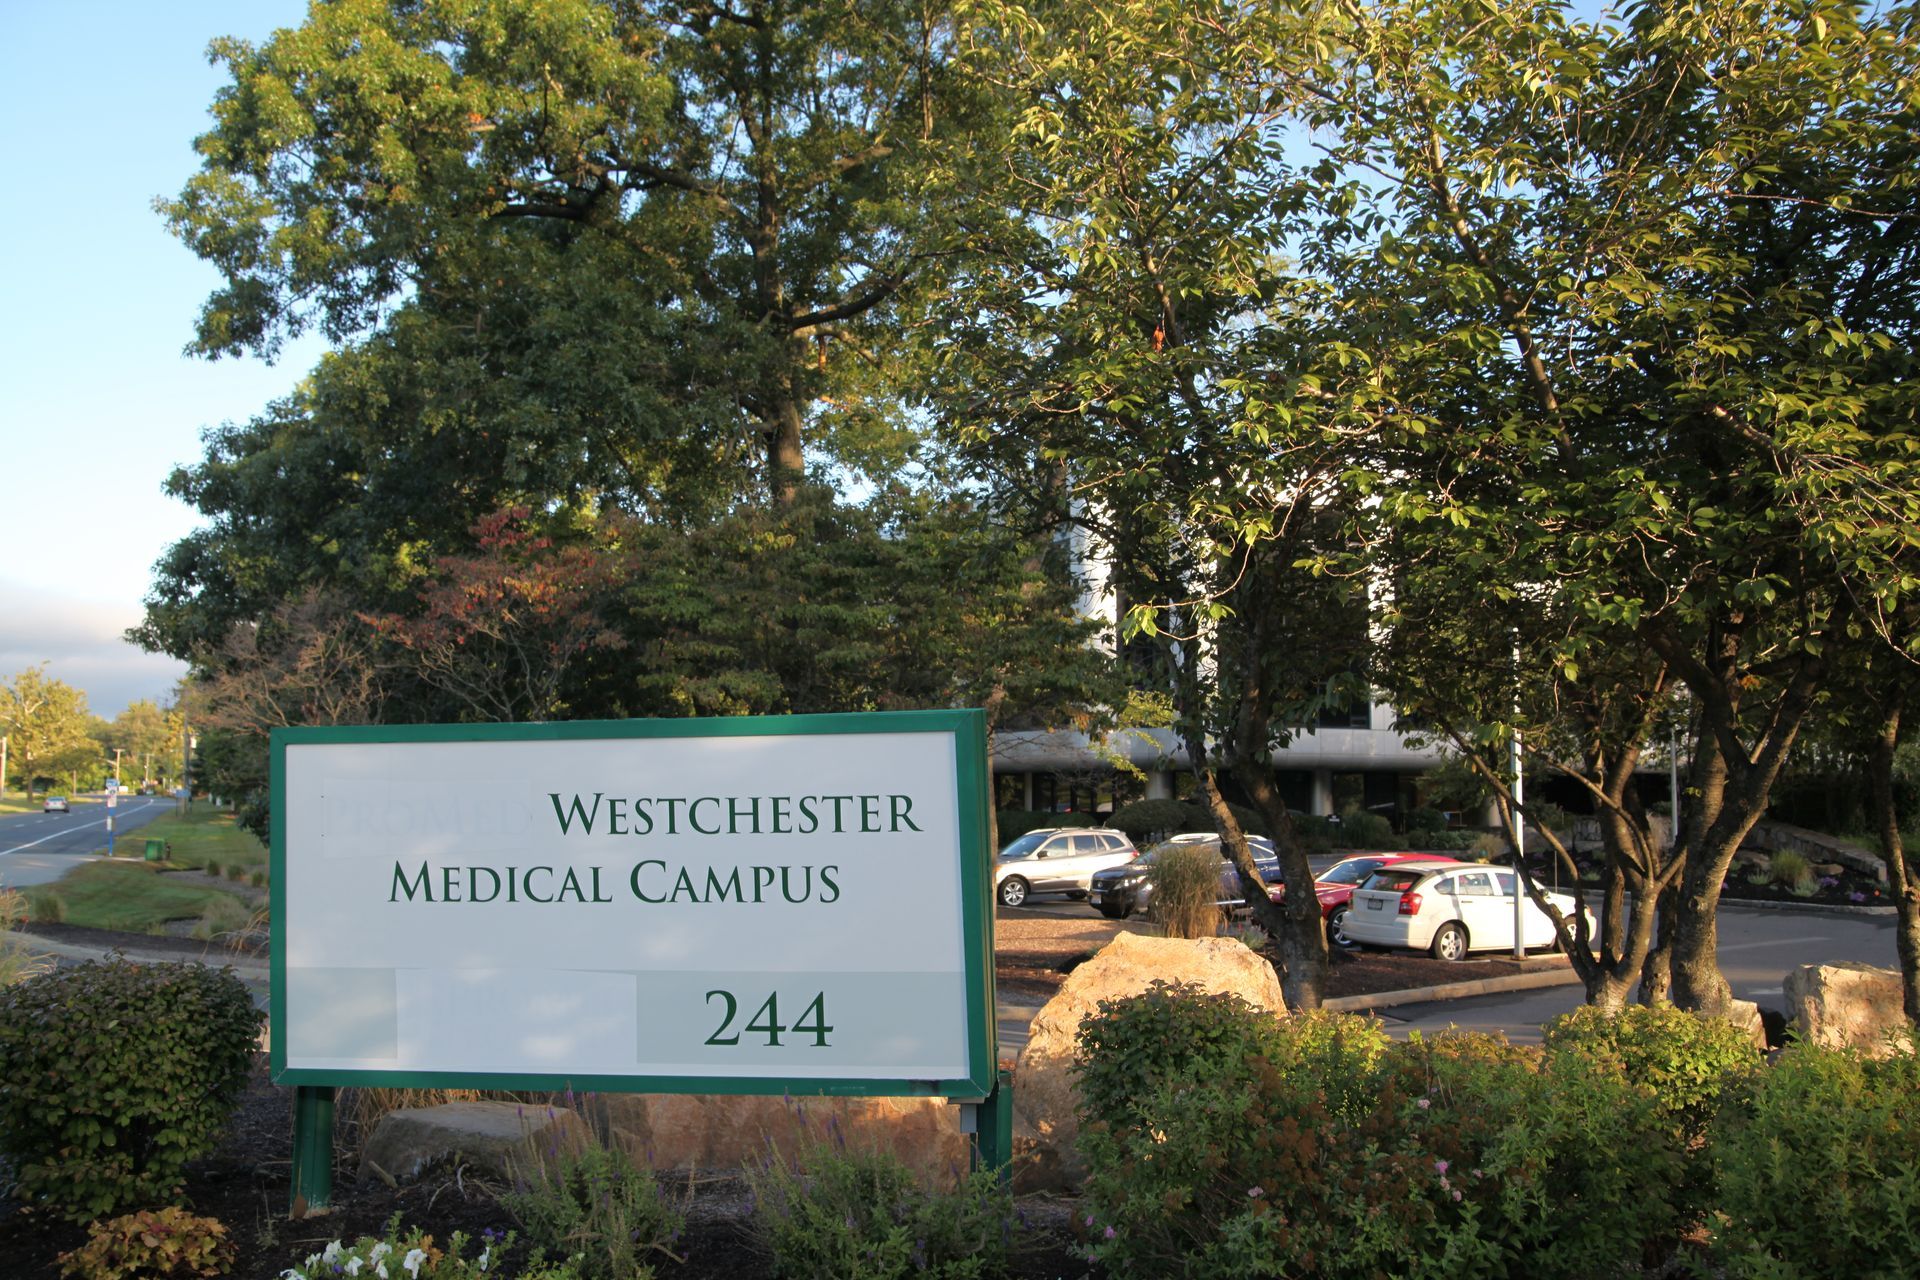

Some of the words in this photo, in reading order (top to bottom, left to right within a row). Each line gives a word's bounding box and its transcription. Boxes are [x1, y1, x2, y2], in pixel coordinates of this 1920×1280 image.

[548, 792, 924, 836] WESTCHESTER
[388, 860, 613, 904] MEDICAL
[629, 859, 841, 904] CAMPUS
[703, 989, 835, 1048] 244
